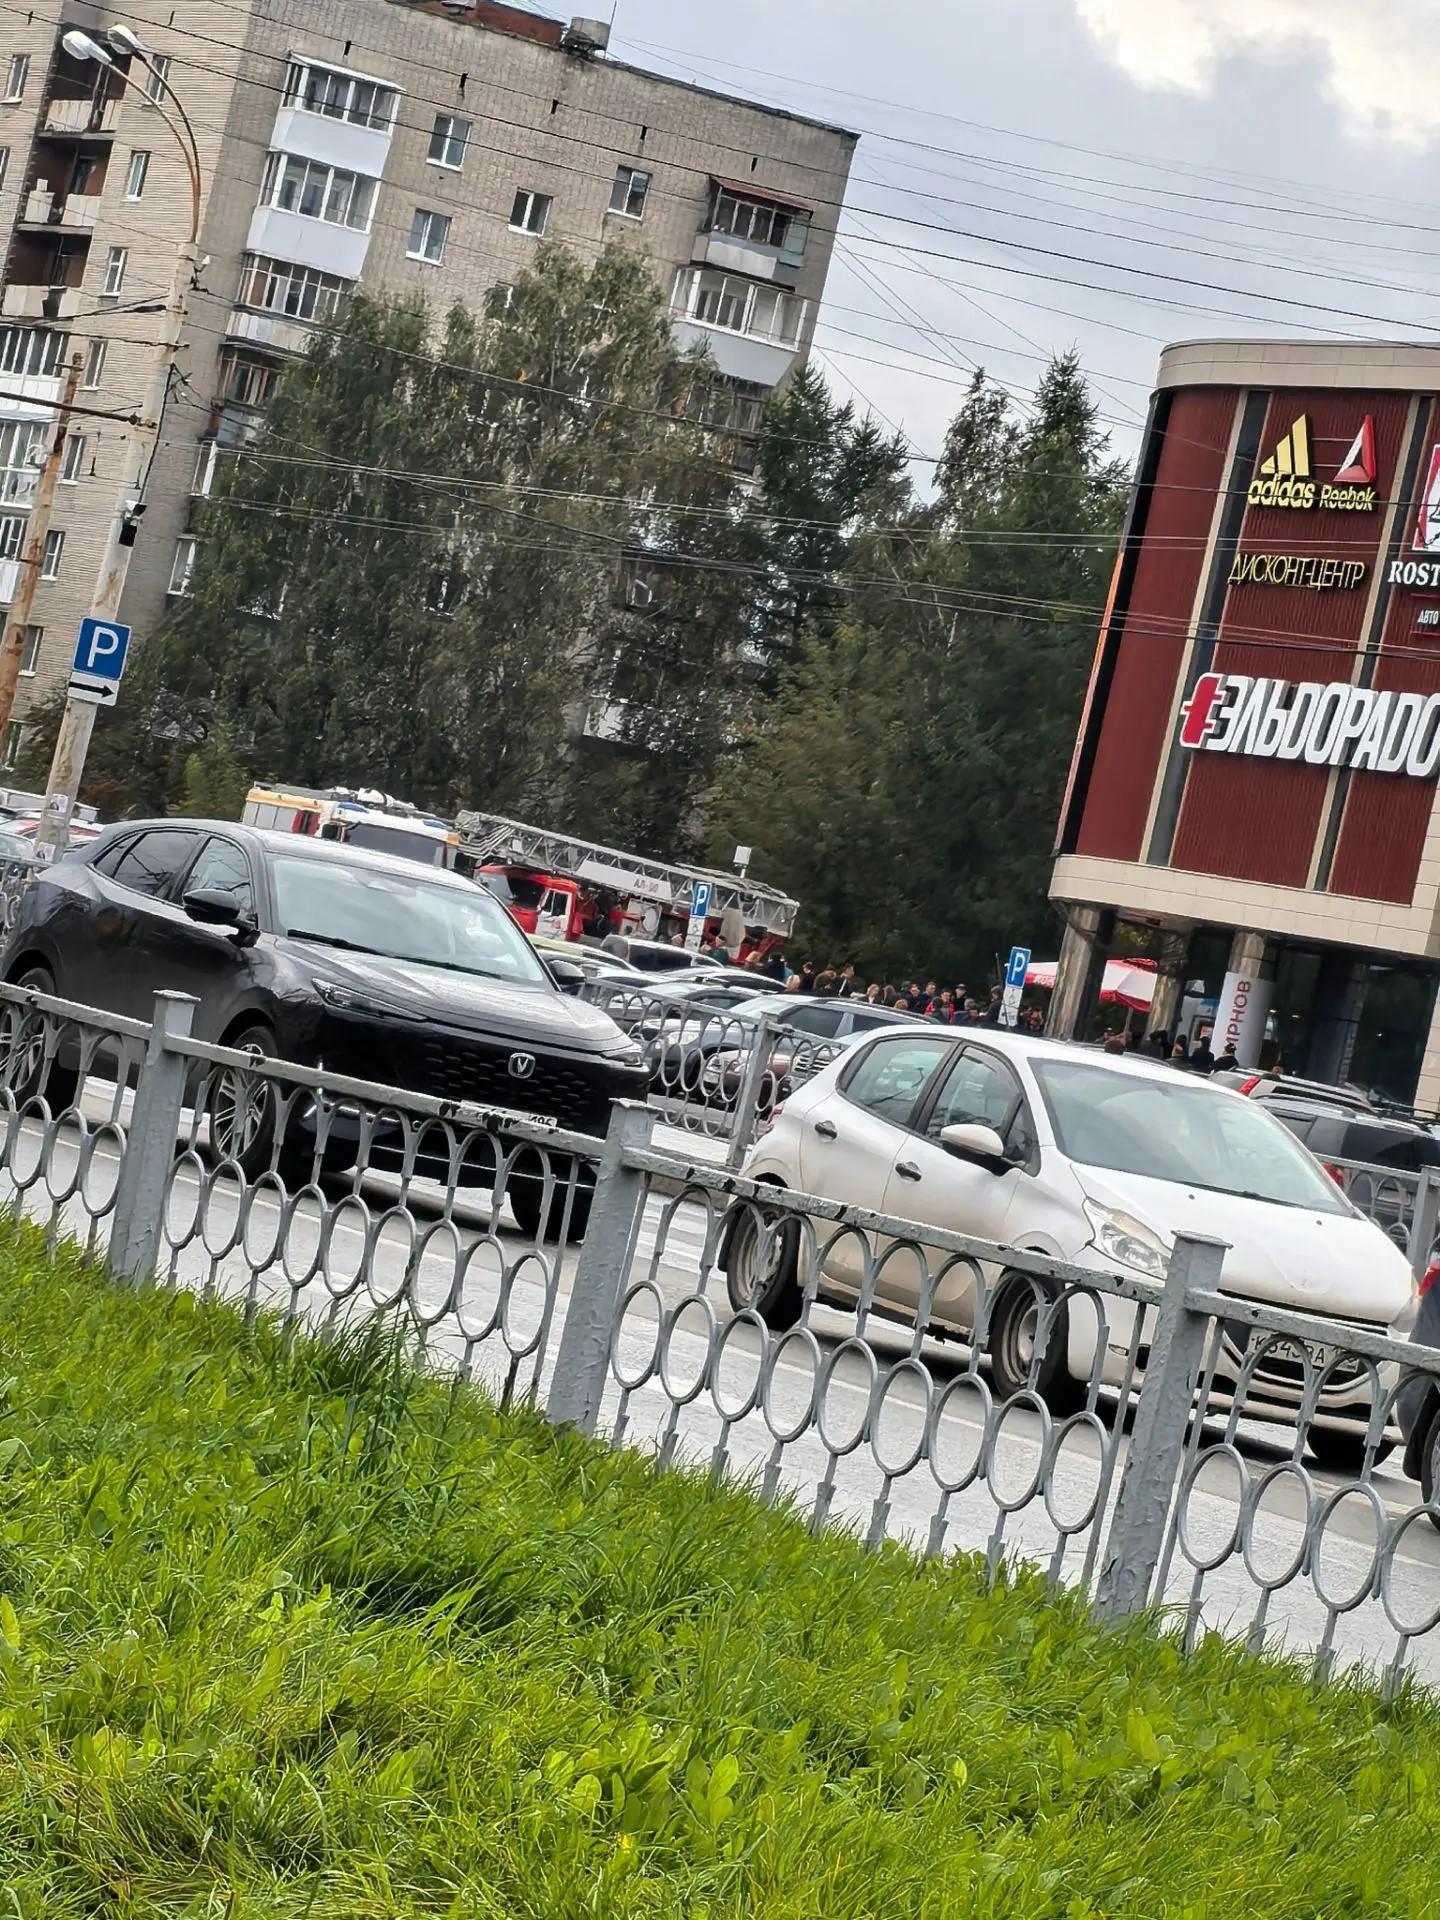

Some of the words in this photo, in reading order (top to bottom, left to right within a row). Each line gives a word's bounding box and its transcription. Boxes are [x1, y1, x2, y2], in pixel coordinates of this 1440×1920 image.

[1247, 473, 1315, 509] adidas
[1319, 484, 1376, 511] Reebok
[1230, 553, 1365, 591] ДИСКОНТ-ЦЕНТР
[87, 626, 119, 667] P
[694, 885, 708, 914] P
[1011, 952, 1026, 982] P
